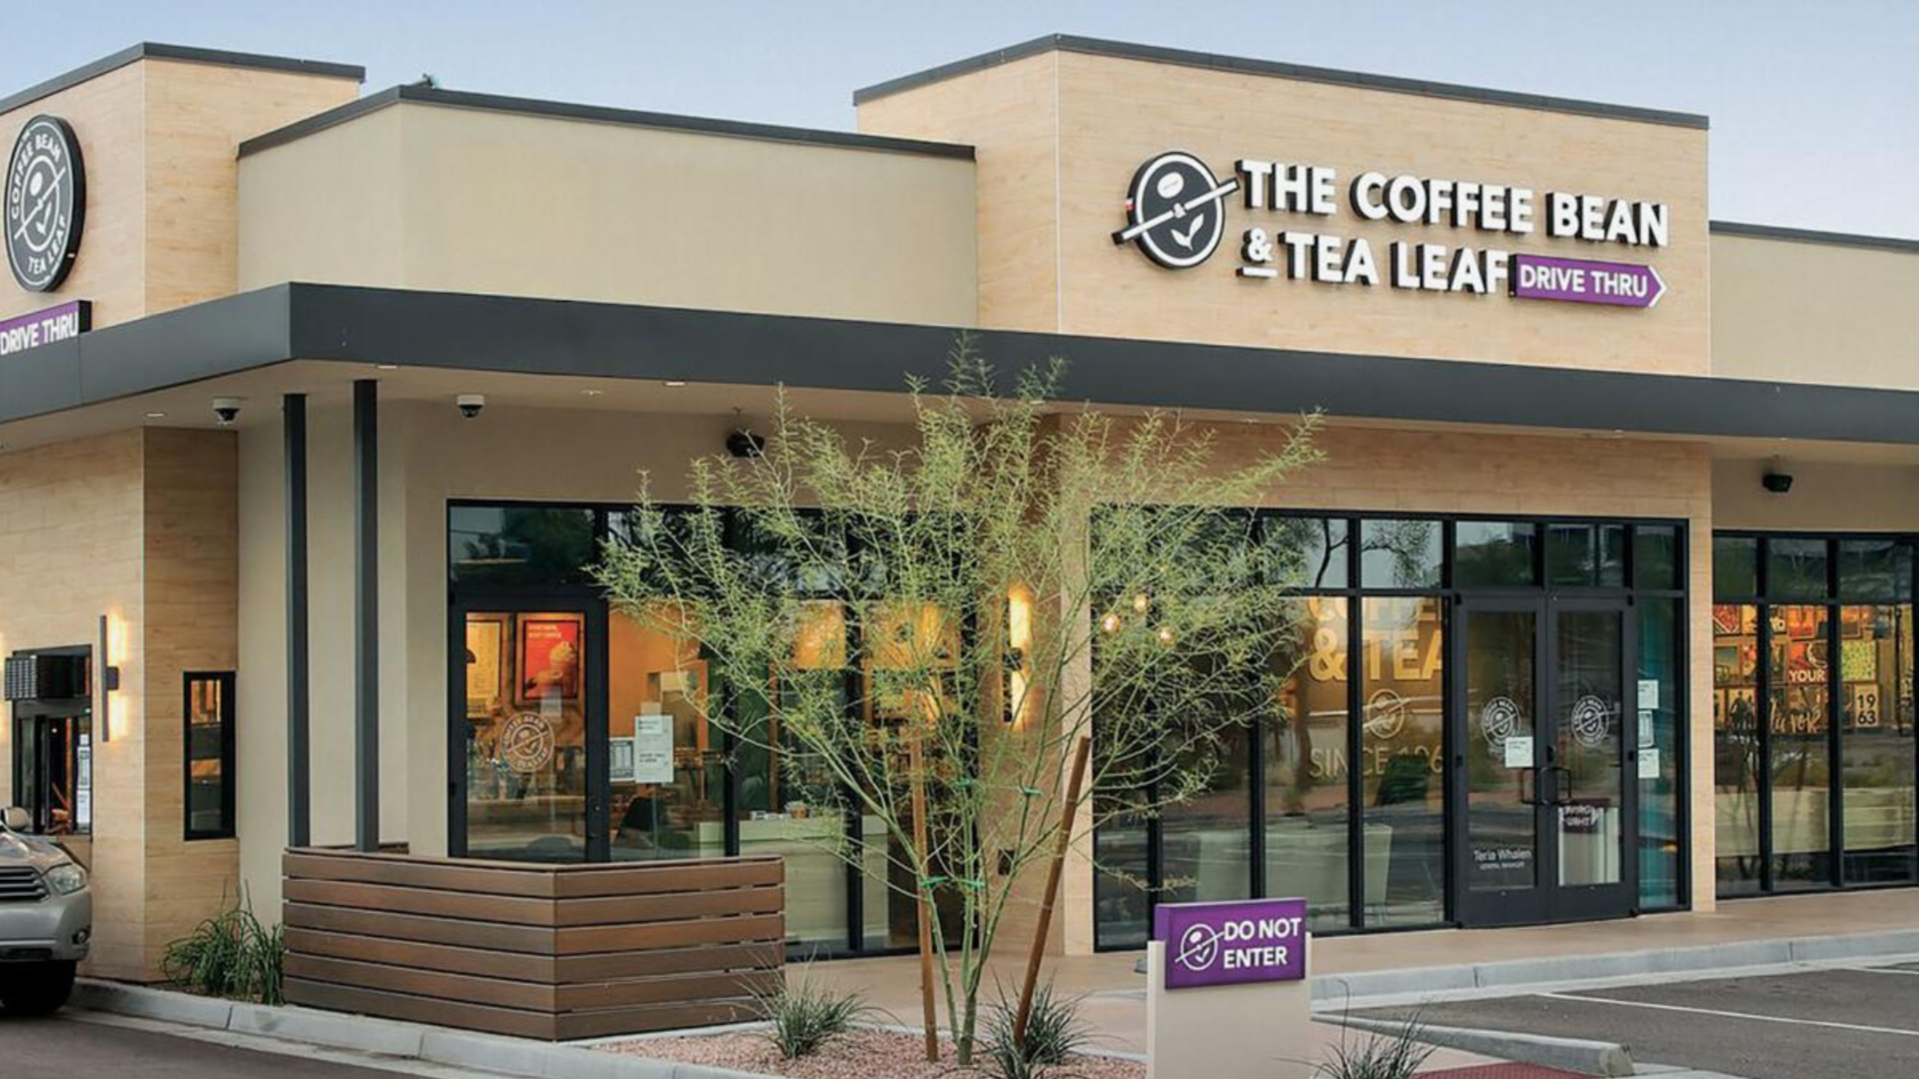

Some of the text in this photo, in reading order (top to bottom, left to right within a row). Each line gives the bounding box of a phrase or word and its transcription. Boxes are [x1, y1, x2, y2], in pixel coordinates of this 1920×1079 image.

[10, 133, 62, 220] COFFEE BEAN
[1241, 159, 1669, 247] THE COFFEE BEAN
[27, 215, 66, 275] TEA LEAF
[1245, 227, 1509, 295] & TEA LEAF
[1519, 264, 1648, 298] DRIVE THRU
[0, 311, 79, 356] DRIVE THRU
[1310, 627, 1348, 681] &
[1788, 669, 1826, 683] YOUR
[1857, 693, 1877, 709] 19
[1857, 710, 1877, 725] 63
[1223, 917, 1303, 942] DO NOT
[1223, 946, 1288, 970] ENTER
